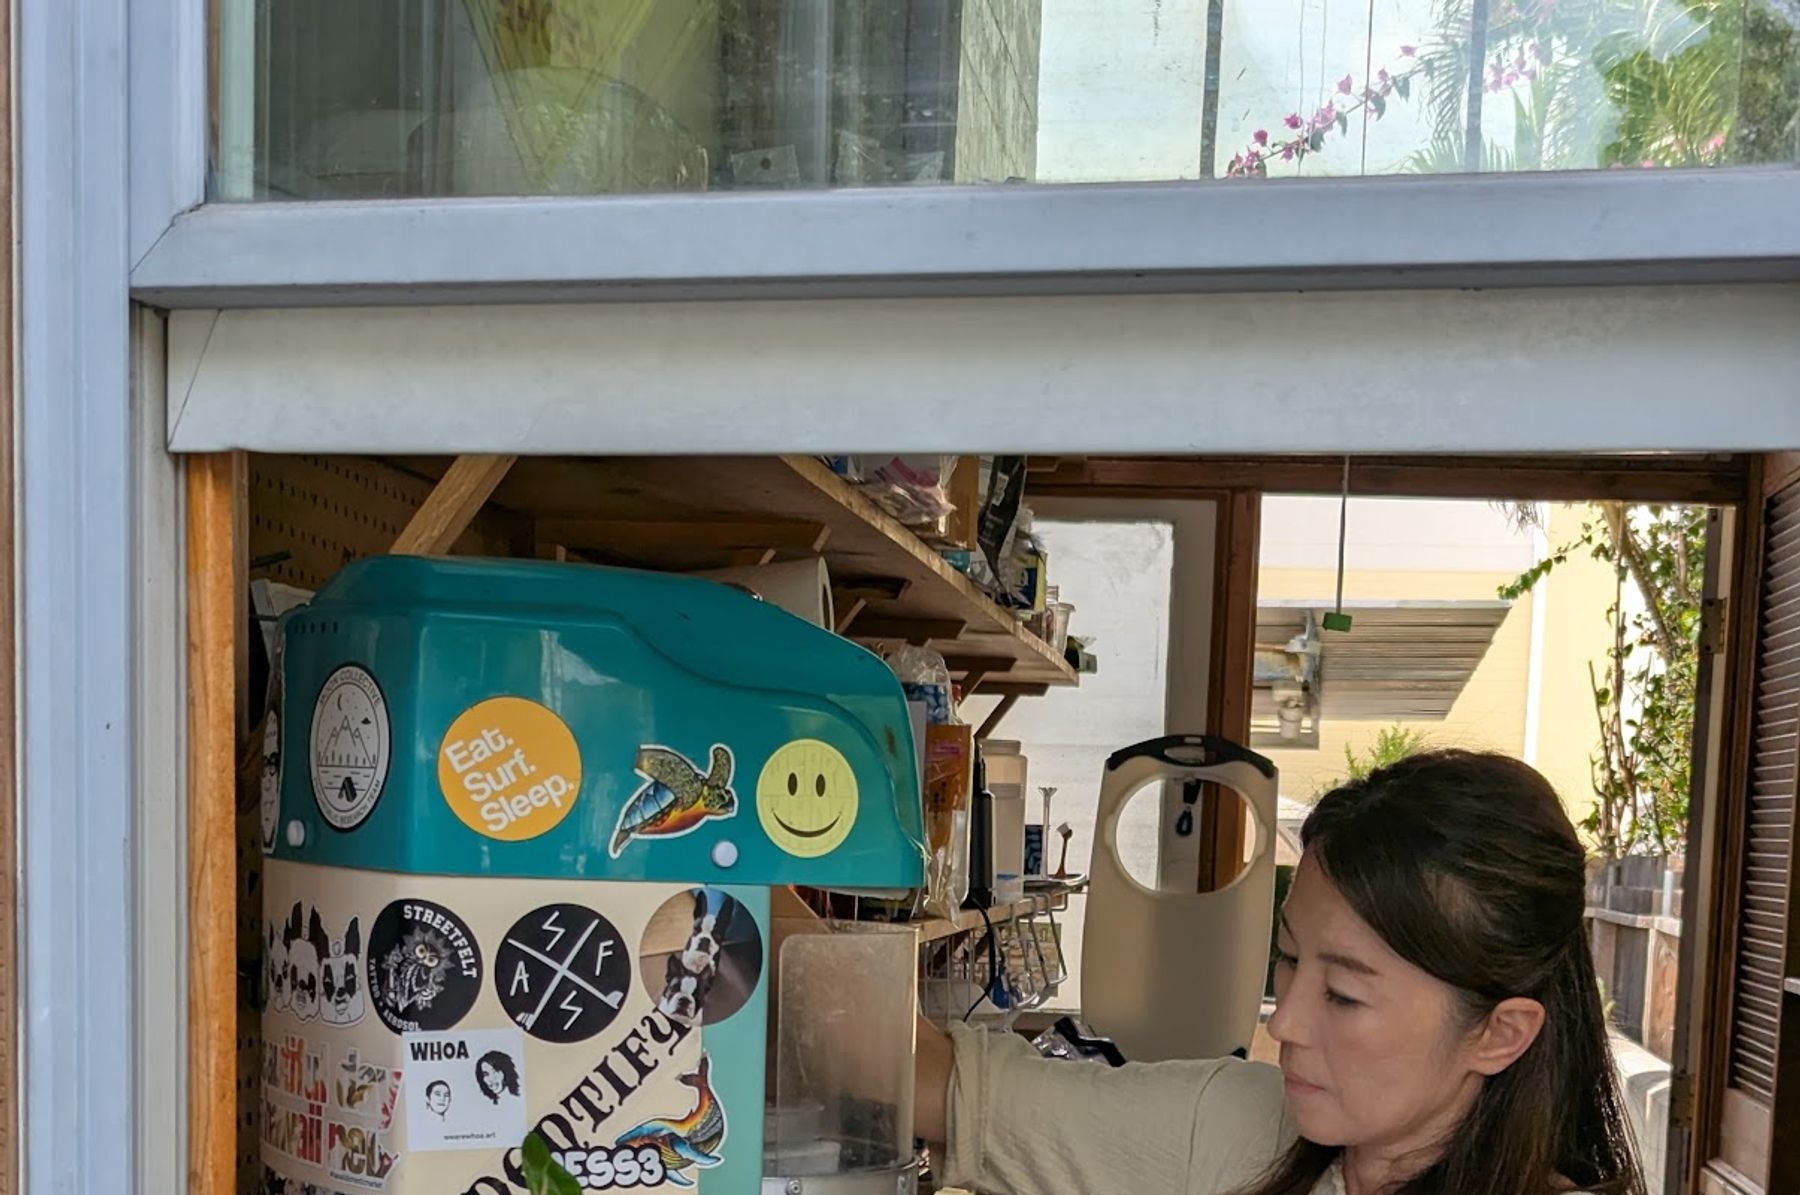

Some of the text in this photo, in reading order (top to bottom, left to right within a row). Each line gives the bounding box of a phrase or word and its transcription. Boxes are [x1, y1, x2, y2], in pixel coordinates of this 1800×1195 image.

[445, 728, 515, 774] Eat.
[463, 748, 538, 802] Surf.
[480, 774, 576, 832] Sleep.
[403, 904, 478, 979] STREETFELT
[595, 940, 615, 977] F
[369, 957, 381, 999] TATTOO
[509, 960, 531, 997] A
[383, 1008, 423, 1032] AEROSOL
[410, 1040, 470, 1061] WHOA
